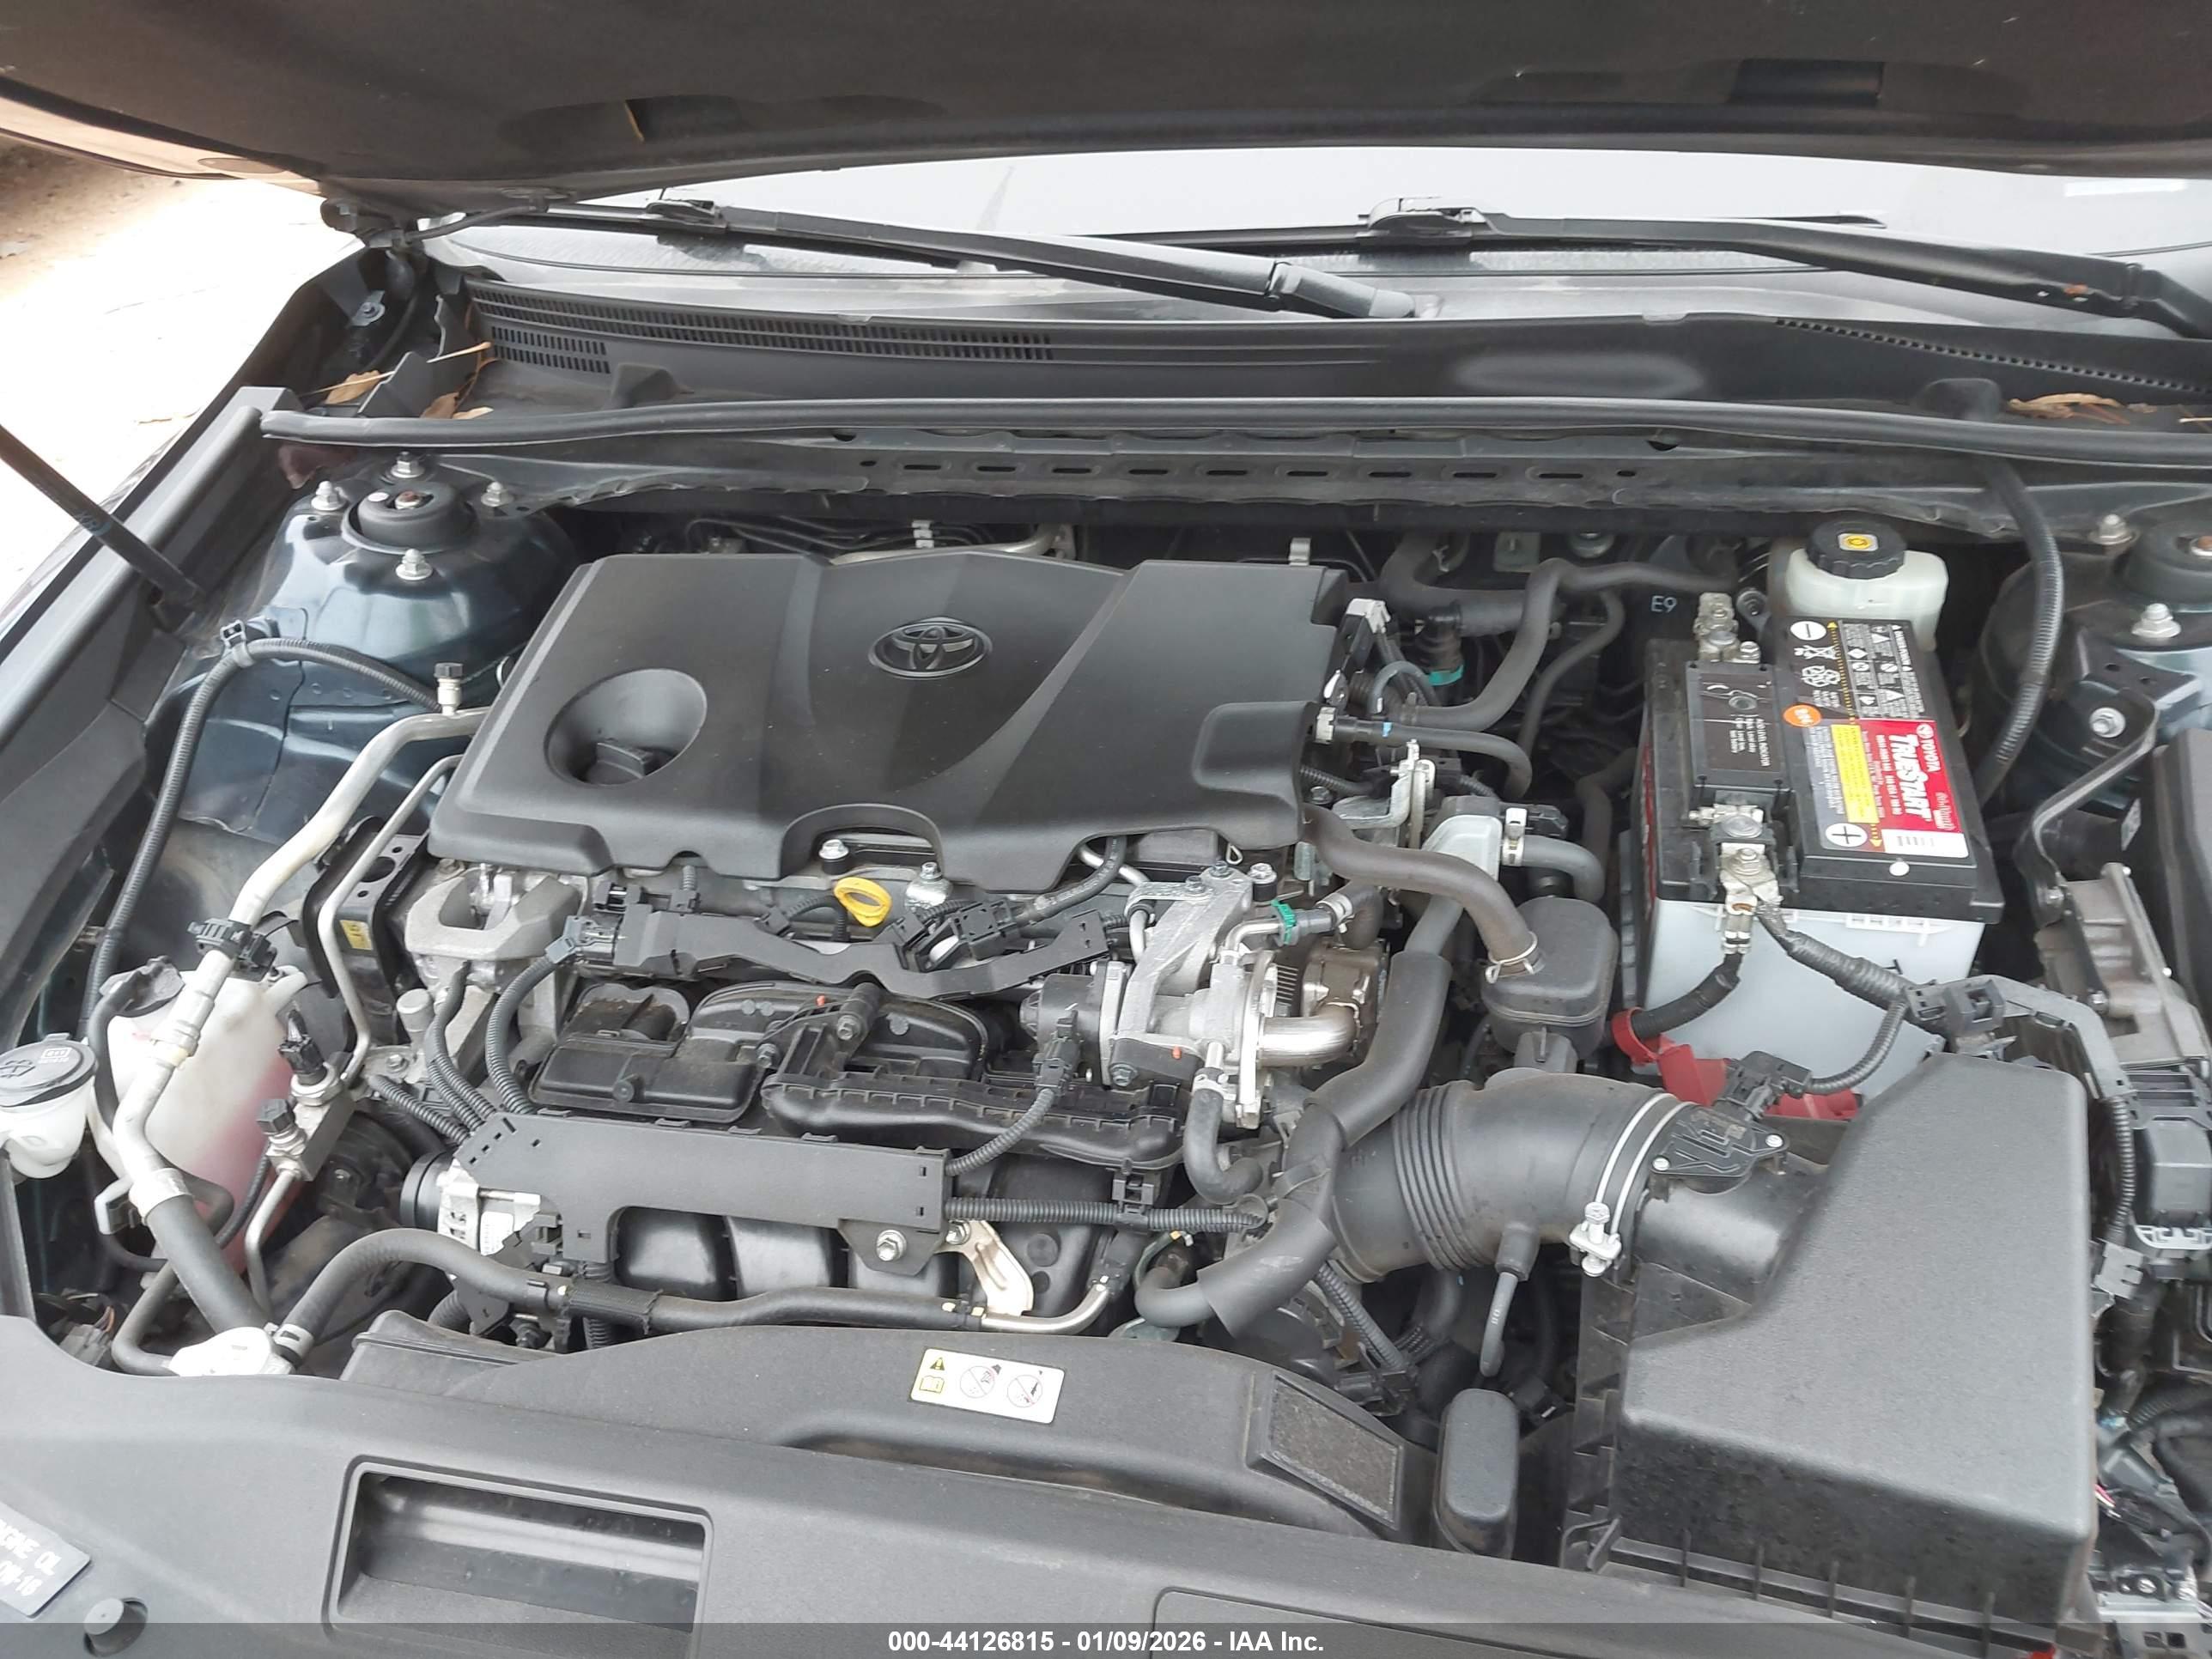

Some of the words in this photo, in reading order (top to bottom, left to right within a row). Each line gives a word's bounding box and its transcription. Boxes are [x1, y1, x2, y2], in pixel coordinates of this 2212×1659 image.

[1650, 596, 1677, 613] E9
[1757, 729, 1768, 742] LEVEL
[1759, 742, 1771, 766] INDICATOR
[1921, 739, 1941, 772] TOYOTA
